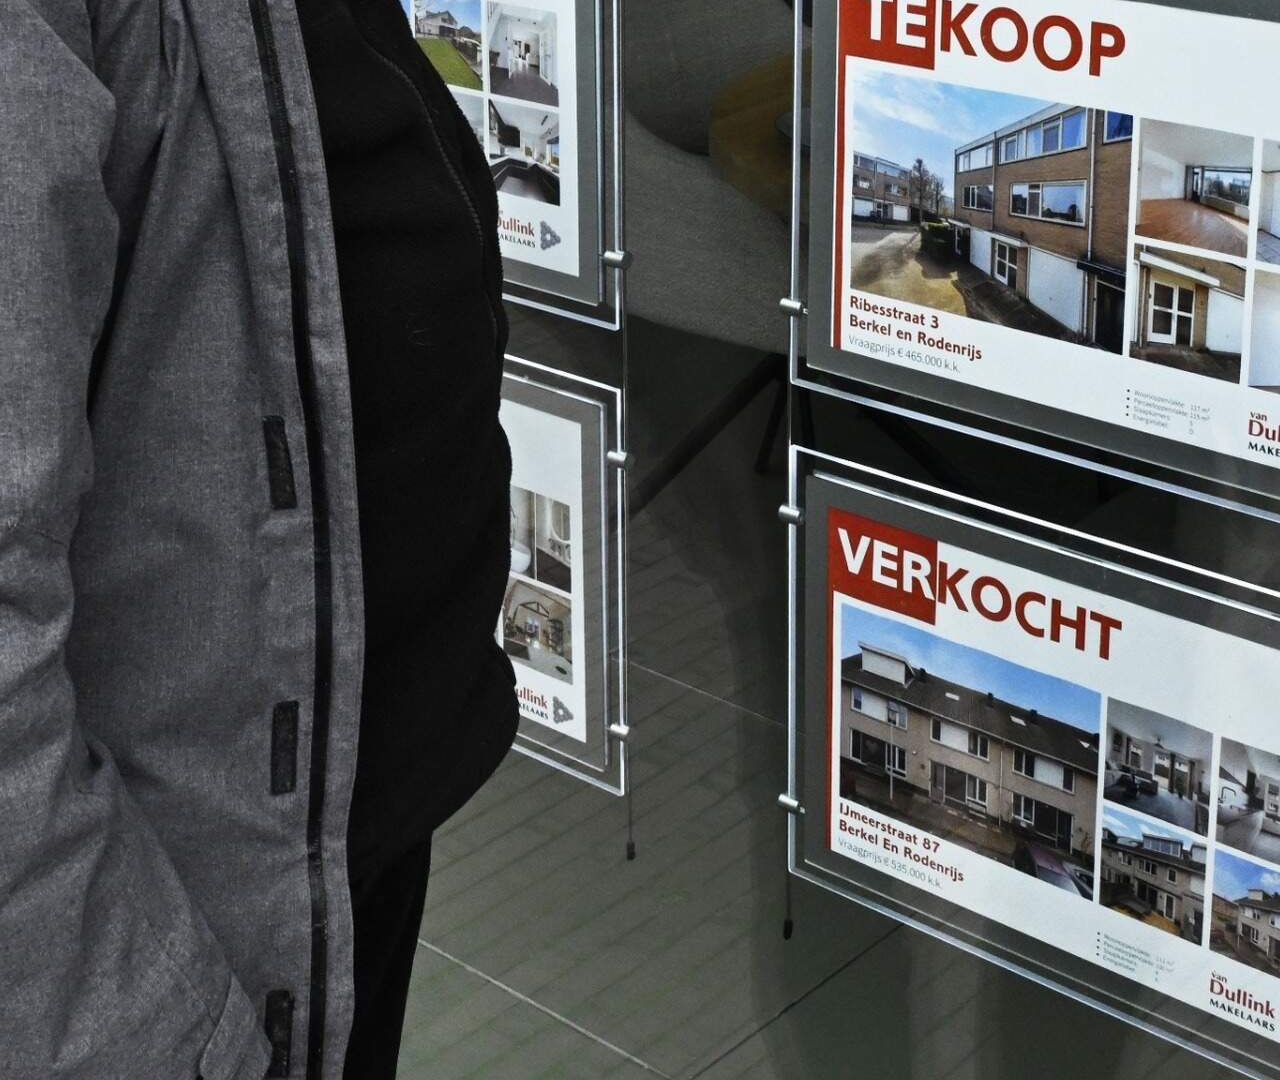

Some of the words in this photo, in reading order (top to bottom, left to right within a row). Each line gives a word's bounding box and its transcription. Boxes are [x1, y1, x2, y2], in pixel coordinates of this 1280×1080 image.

[849, 295, 925, 326] Ribesstraat
[930, 316, 939, 329] 3
[848, 334, 895, 358] Vraagprijs
[849, 314, 891, 336] Berkel
[896, 329, 912, 342] en
[917, 331, 982, 362] Rodenrijs
[1250, 411, 1267, 421] van
[837, 527, 1122, 661] VERKOCHT
[839, 802, 918, 845] IJmeerstraat
[923, 838, 941, 853] 87
[839, 819, 878, 845] Berkel
[883, 838, 898, 854] En
[904, 846, 964, 882] Rodenrijs
[1211, 971, 1227, 983] van
[1210, 978, 1275, 1019] Dullink
[1210, 999, 1275, 1032] MAKELAARS
